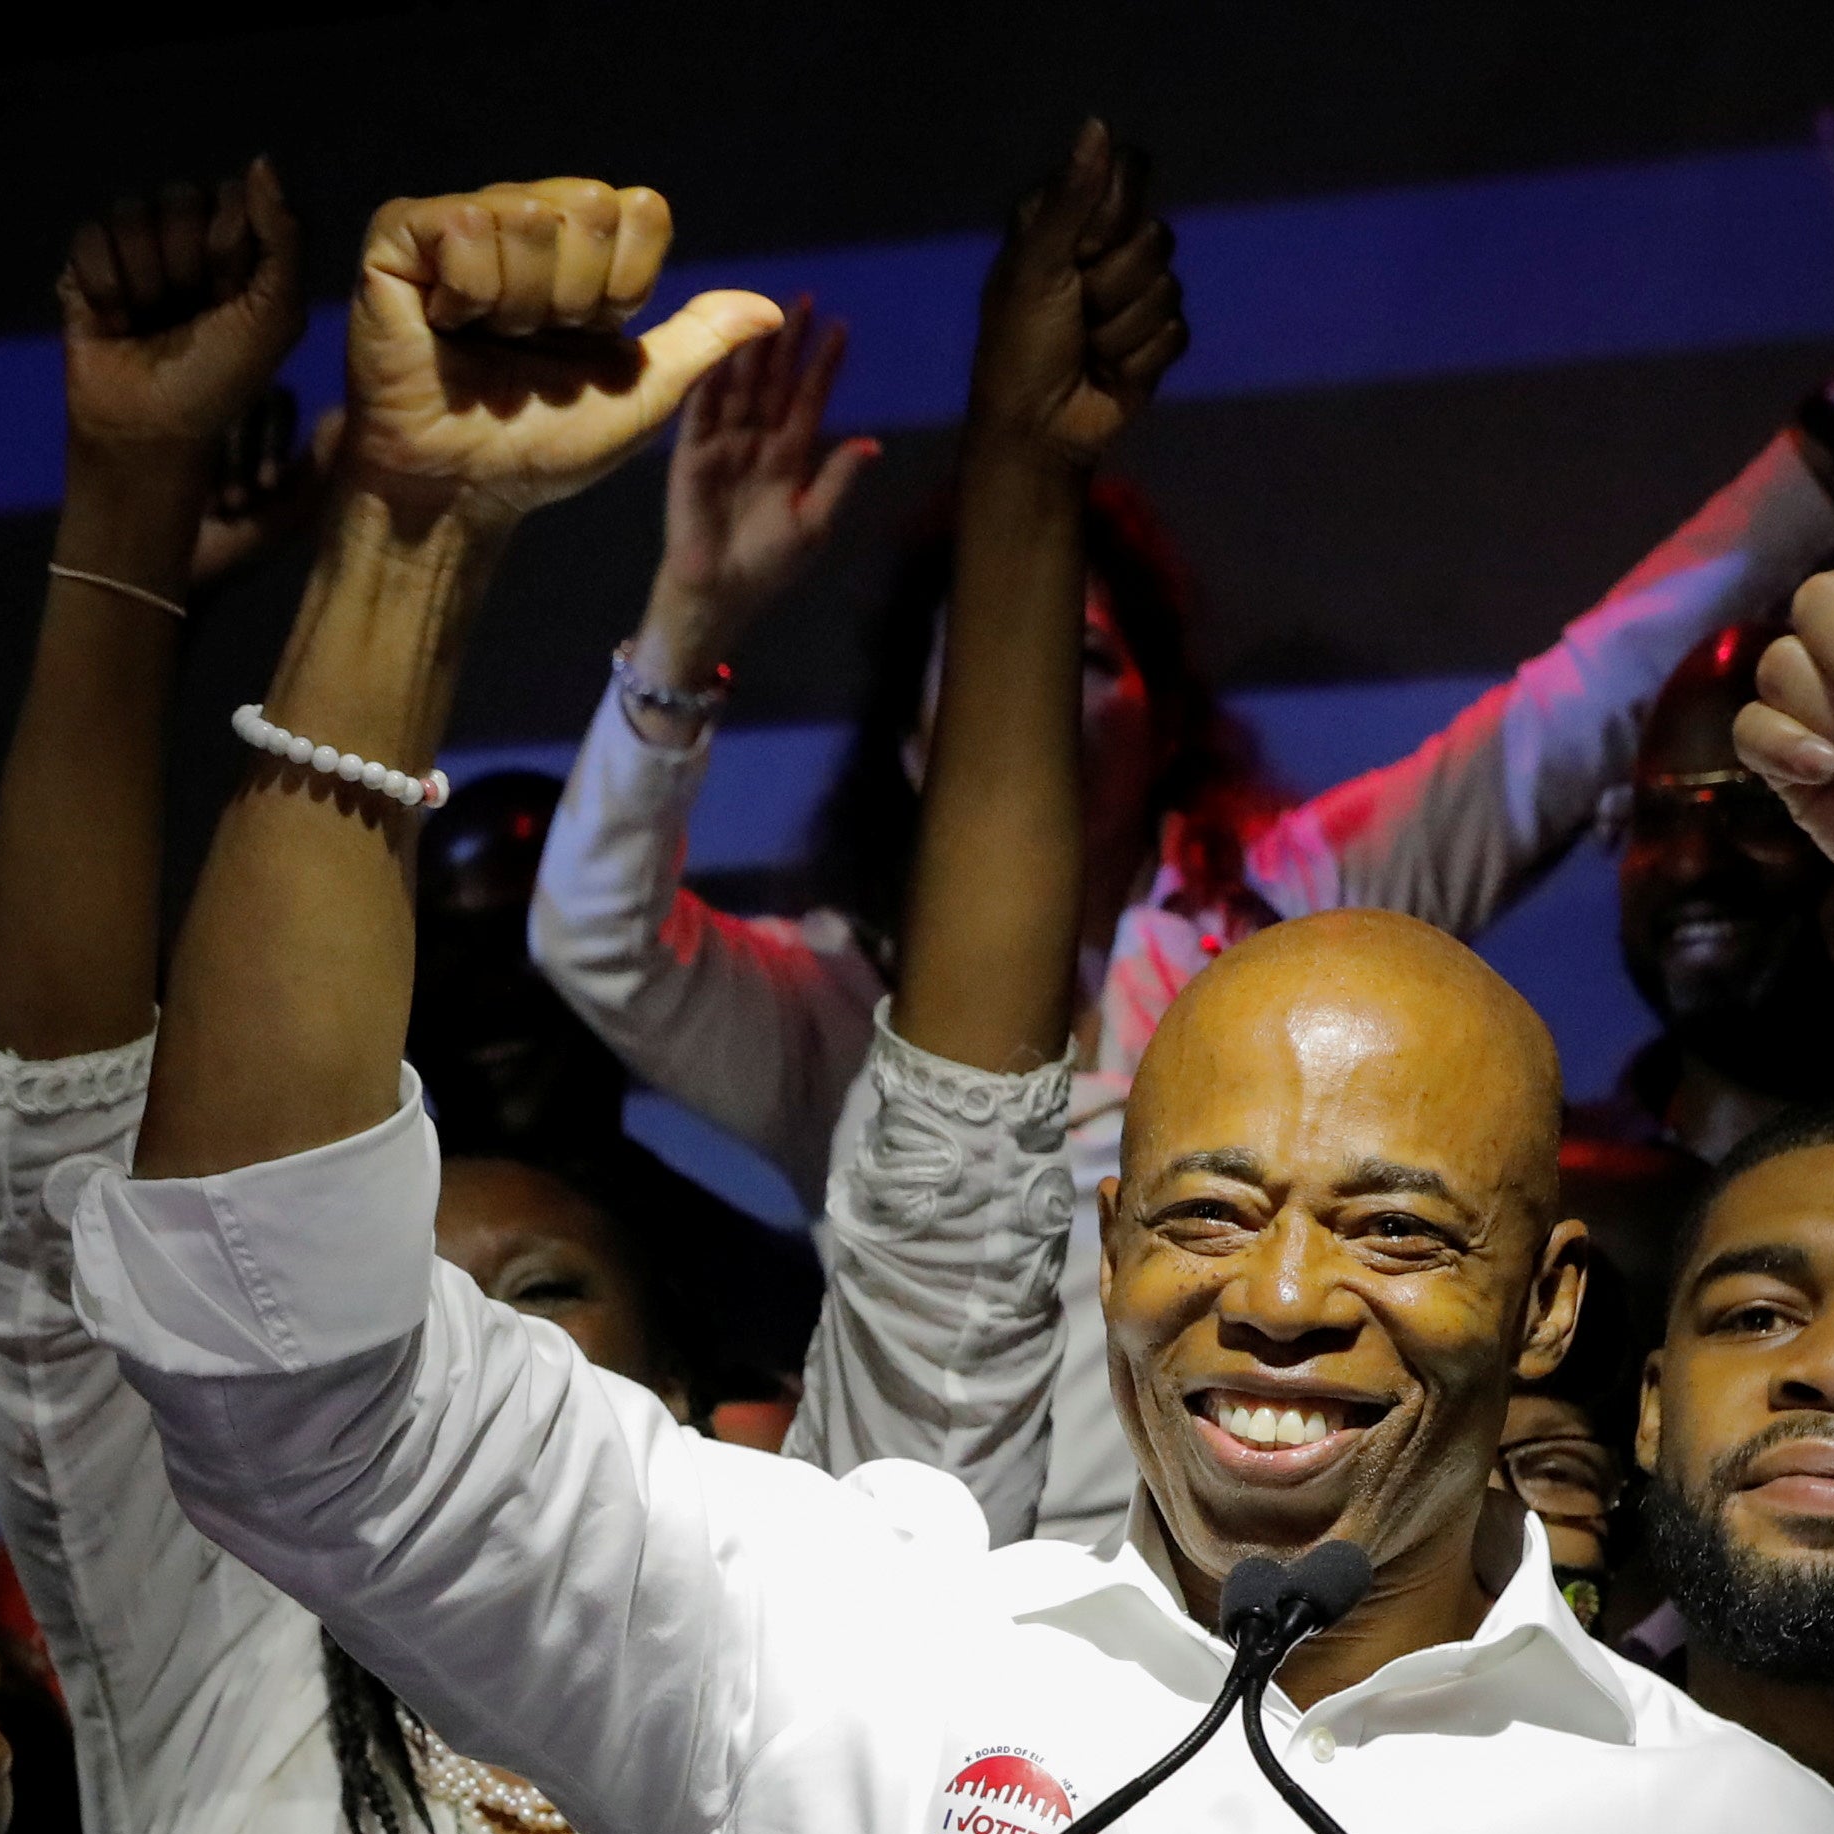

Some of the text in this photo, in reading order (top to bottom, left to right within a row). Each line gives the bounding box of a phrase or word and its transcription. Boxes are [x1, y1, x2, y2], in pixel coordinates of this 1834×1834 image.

[975, 1745, 1029, 1759] BOARD OF
[943, 1809, 953, 1831] I
